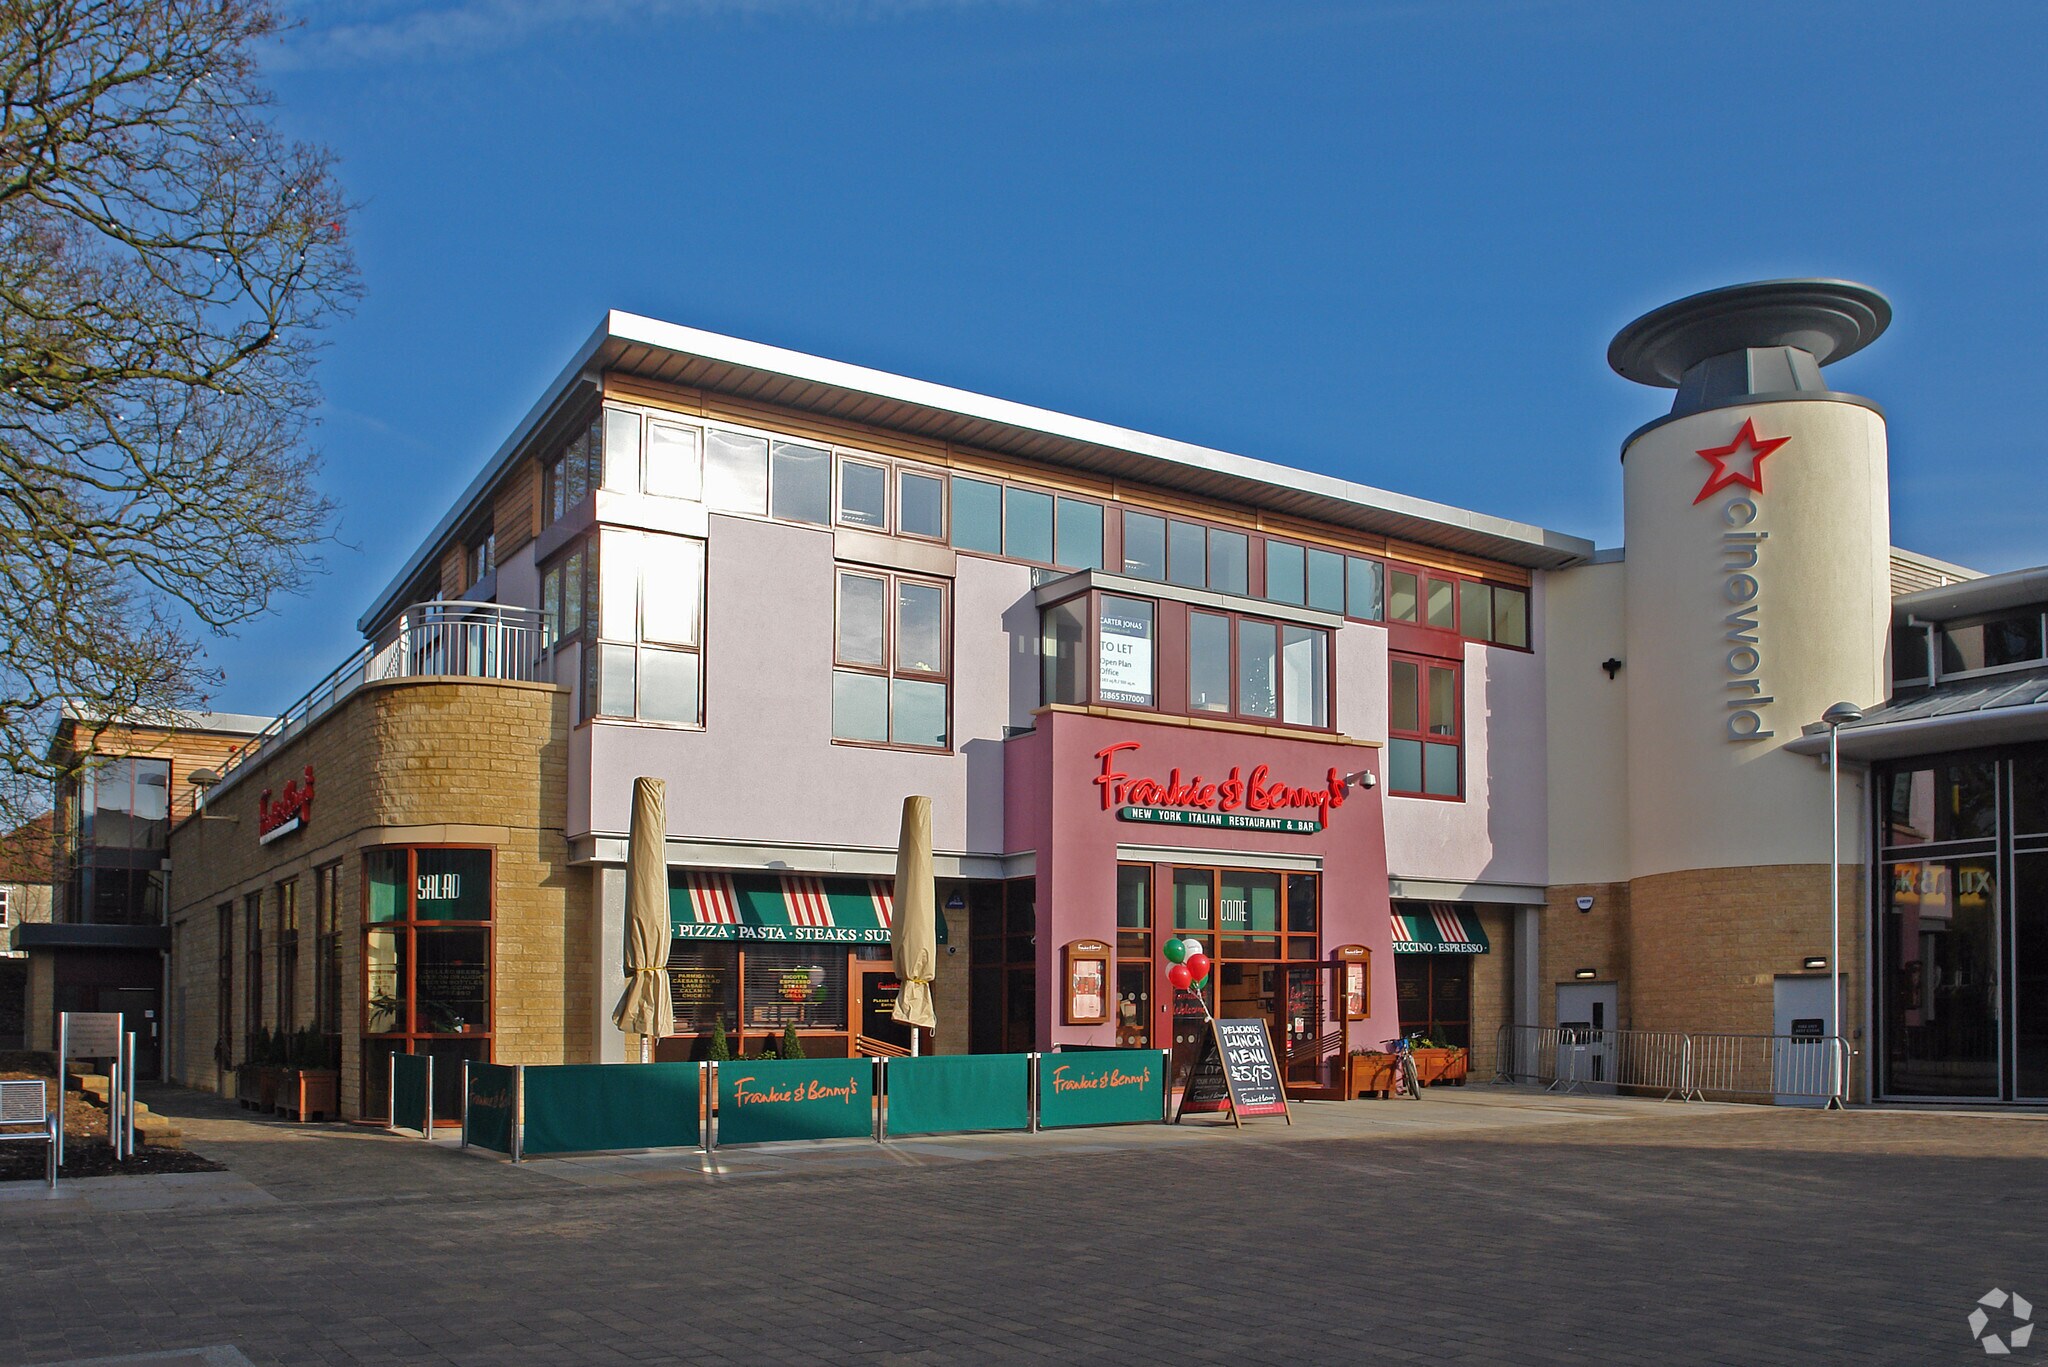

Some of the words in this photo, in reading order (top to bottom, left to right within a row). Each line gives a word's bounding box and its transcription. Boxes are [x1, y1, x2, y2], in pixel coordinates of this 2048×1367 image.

[1123, 618, 1143, 630] JONAS
[1722, 497, 1774, 742] cineworld
[1101, 641, 1114, 652] TO
[1117, 643, 1133, 655] LET
[1118, 659, 1132, 668] Plan
[1121, 693, 1145, 703] 517000
[1095, 741, 1217, 810] Frankie
[1219, 766, 1244, 810] &
[1247, 764, 1345, 828] Benny's
[1132, 808, 1152, 819] NEW
[1158, 810, 1182, 822] YORK
[1188, 812, 1222, 825] ITALIAN
[1229, 816, 1281, 829] RESTAURANT
[1286, 820, 1293, 830] &
[1298, 821, 1314, 831] BAR
[417, 873, 460, 900] SALAD
[679, 924, 729, 938] PIZZA
[738, 926, 787, 940] PASTA
[795, 927, 857, 941] STEAKS
[1438, 942, 1483, 953] ESPRESSO
[1221, 1025, 1261, 1035] DELICIOUS
[1224, 1034, 1264, 1048] LUNCH
[1228, 1048, 1269, 1064] MENU
[1053, 1065, 1098, 1094] Frankie
[1099, 1071, 1108, 1088] &
[1110, 1066, 1150, 1091] Benny's
[1231, 1065, 1272, 1086] £5.95
[734, 1077, 792, 1107] Frankie
[793, 1082, 805, 1101] &
[808, 1077, 858, 1104] Benny's
